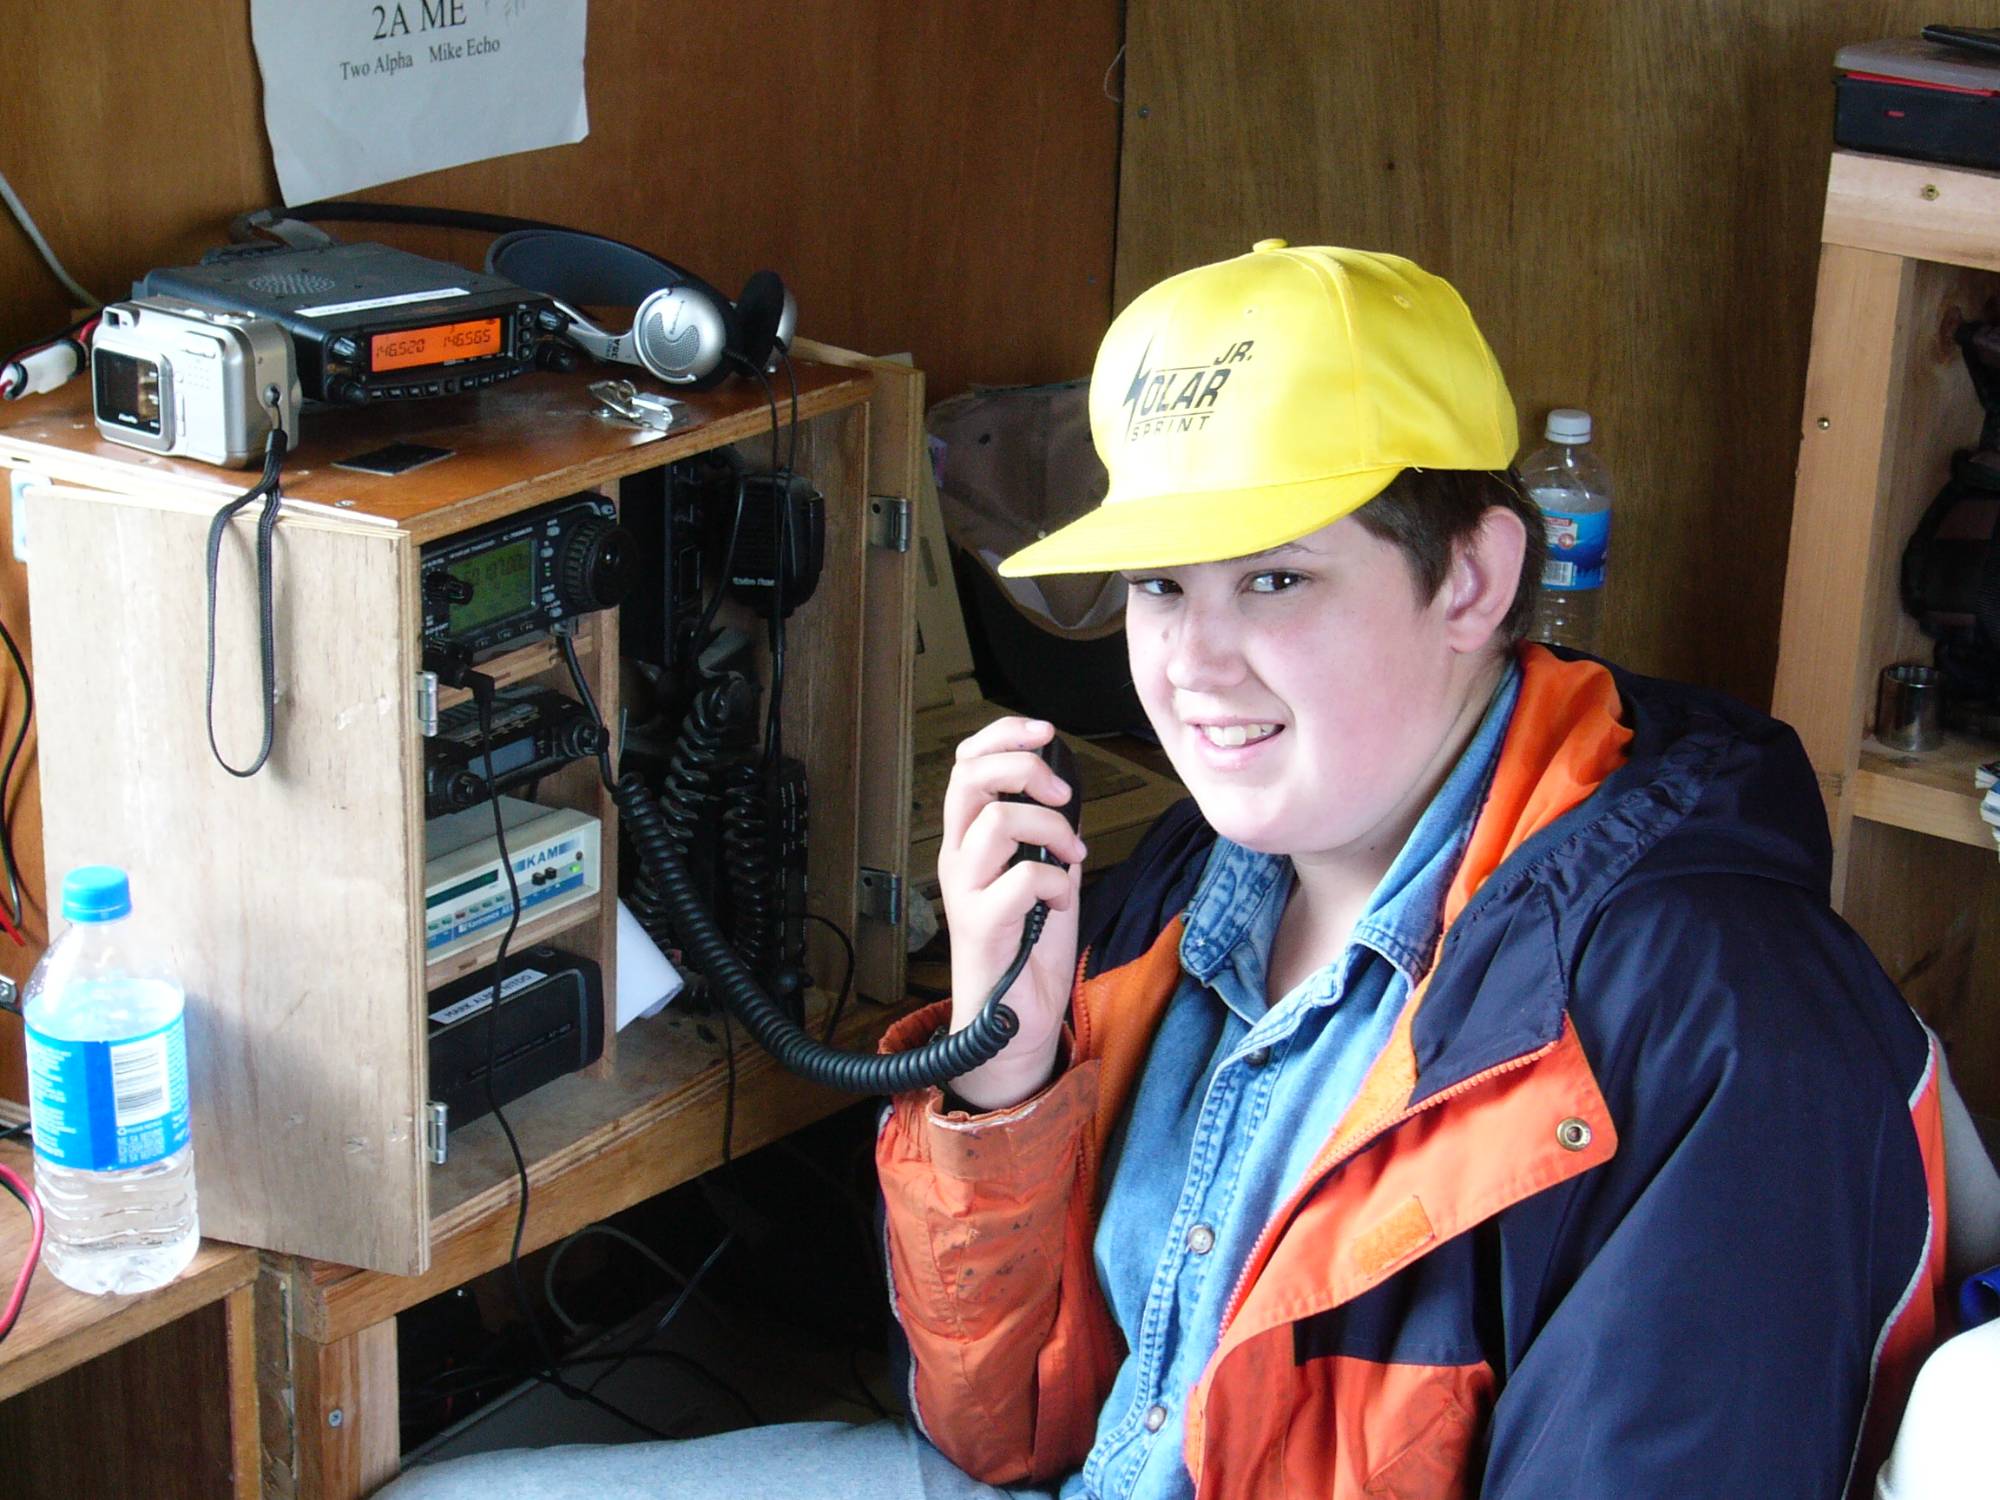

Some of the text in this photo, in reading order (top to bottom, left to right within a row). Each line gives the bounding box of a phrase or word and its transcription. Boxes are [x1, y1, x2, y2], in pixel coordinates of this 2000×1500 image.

[372, 4, 411, 40] 2A
[420, 0, 468, 31] ME
[340, 35, 501, 80] Two Alpha Mike Echo
[1213, 340, 1255, 366] JR.
[1131, 415, 1211, 442] SPRINT
[525, 845, 560, 869] KAM
